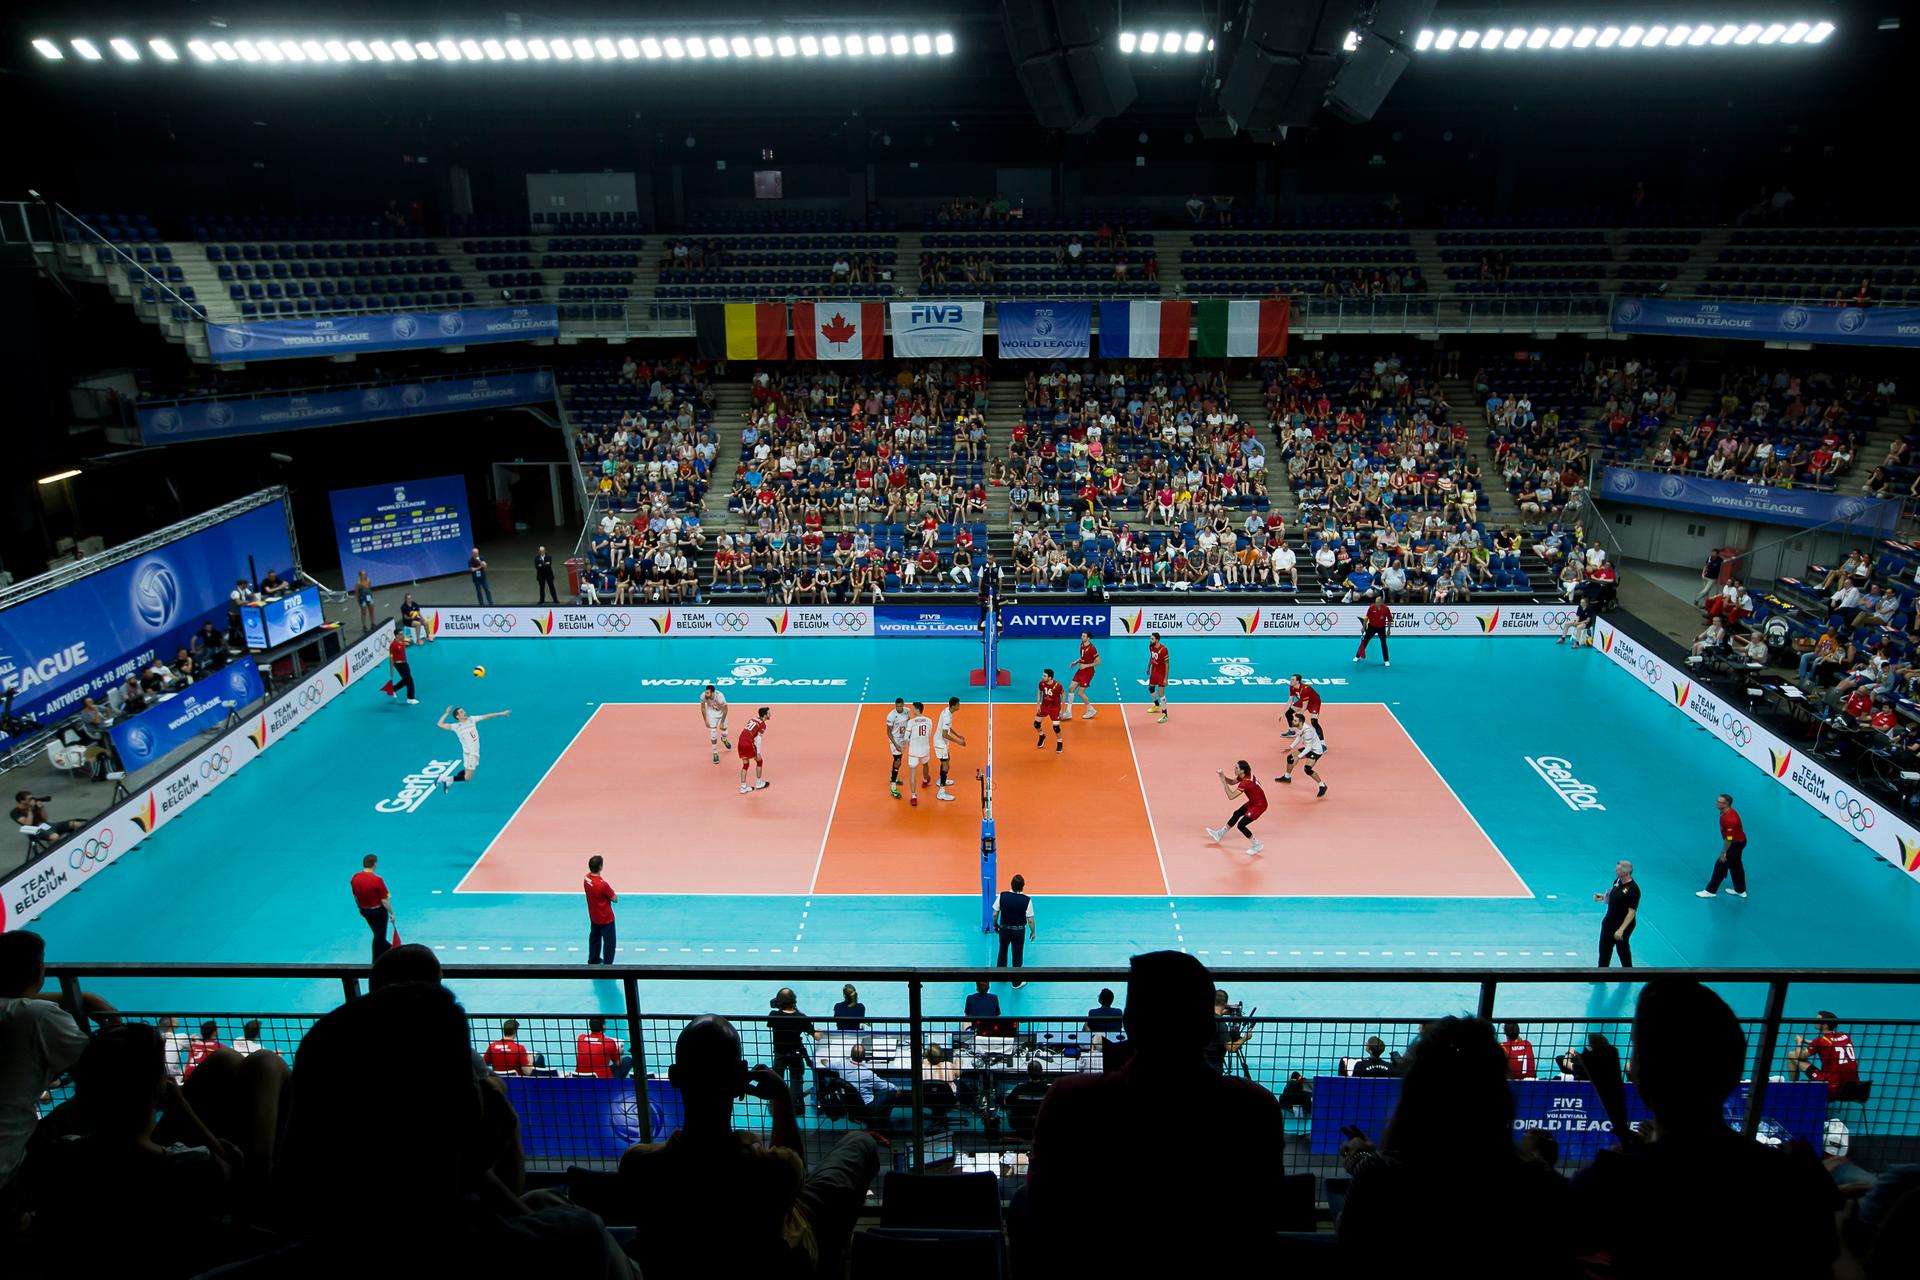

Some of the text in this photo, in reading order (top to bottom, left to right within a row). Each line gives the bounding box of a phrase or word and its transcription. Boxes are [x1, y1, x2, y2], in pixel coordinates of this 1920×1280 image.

[911, 305, 963, 324] FIVB
[1666, 316, 1752, 328] WORLD LEAGUE
[486, 320, 559, 331] WORLD LEAGUE
[282, 332, 370, 345] WORLD LEAGUE
[1001, 340, 1088, 348] WORLD LEAGUE
[1711, 495, 1806, 514] WORLD LEAGUE
[284, 594, 302, 610] FIVB
[682, 613, 705, 621] TEAM
[799, 613, 822, 621] TEAM
[1009, 614, 1107, 626] ANTWERP
[1270, 612, 1293, 620] TEAM
[1391, 612, 1414, 620] TEAM
[1510, 612, 1532, 620] TEAM
[445, 622, 480, 630] BELGIUM
[558, 622, 594, 630] BELGIUM
[676, 621, 712, 629] BELGIUM
[793, 621, 829, 629] BELGIUM
[1146, 621, 1182, 629] BELGIUM
[1502, 620, 1539, 628] BELGIUM
[354, 647, 369, 661] TEAM
[1619, 640, 1634, 655] TEAM
[352, 652, 374, 673] BELGIUM
[1613, 646, 1637, 668] BELGIUM
[0, 641, 89, 703] EAGUE
[46, 684, 91, 715] ANTWERP
[91, 671, 115, 690] 16-18
[115, 660, 137, 679] JUNE
[137, 649, 155, 668] 2017
[1044, 687, 1053, 696] 16
[274, 702, 292, 719] TEAM
[1697, 694, 1716, 713] TEAM
[168, 712, 195, 730] WORLD
[193, 696, 221, 716] LEAGUE
[271, 706, 298, 733] BELGIUM
[1690, 700, 1719, 726] BELGIUM
[918, 724, 927, 736] 18
[1537, 756, 1607, 811] Gerflor
[1801, 764, 1825, 789] TEAM
[166, 774, 191, 797] TEAM
[375, 760, 453, 813] Gerflor
[1791, 771, 1830, 804] BELGIUM
[161, 781, 199, 813] BELGIUM
[21, 866, 55, 896] TEAM
[15, 872, 68, 915] BELGIUM
[1834, 1043, 1856, 1065] 20
[1553, 1098, 1583, 1108] FIVB
[1512, 1119, 1641, 1133] ORLD LEAGE
